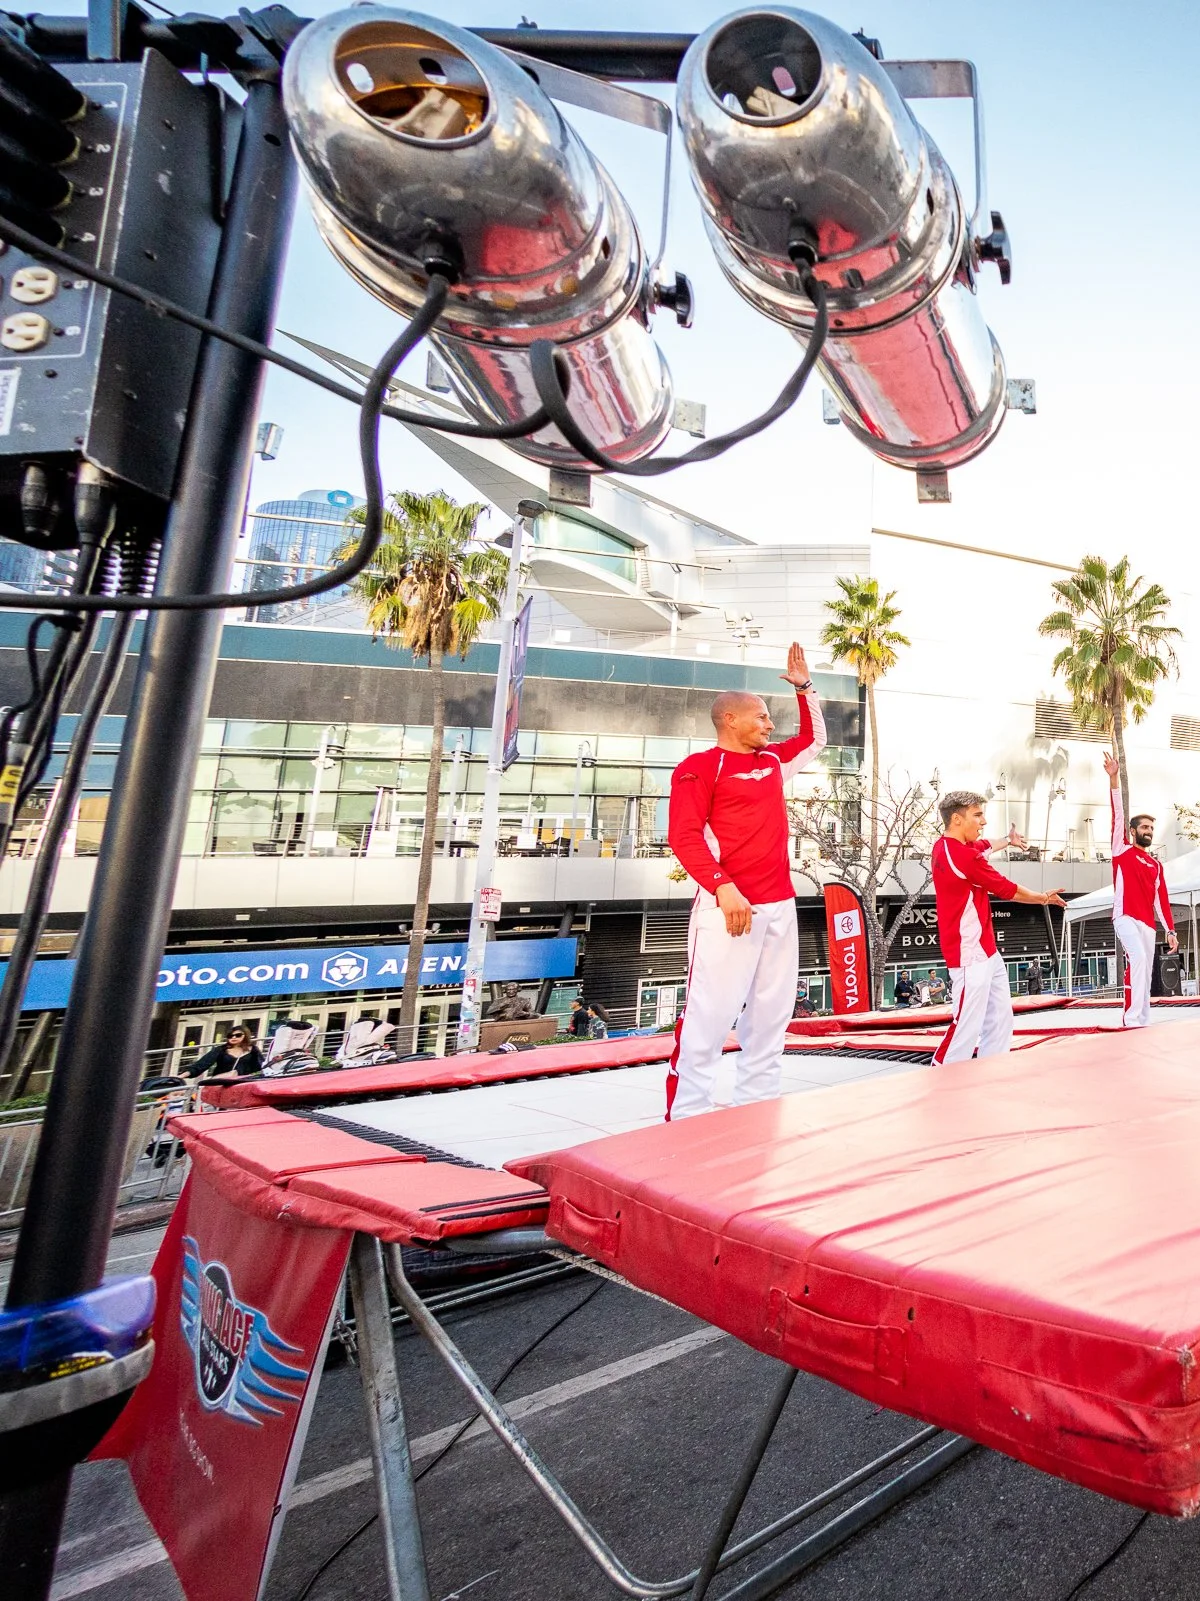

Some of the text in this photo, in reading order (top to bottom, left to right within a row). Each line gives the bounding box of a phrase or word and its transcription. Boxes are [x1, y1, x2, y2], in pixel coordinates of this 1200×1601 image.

[103, 100, 118, 110] 1
[96, 143, 112, 153] 2
[89, 186, 104, 197] 3
[80, 232, 96, 243] 4
[73, 279, 89, 290] 5
[902, 934, 937, 947] BOX
[156, 955, 467, 987] to.com AEN
[843, 942, 859, 1009] TOYOTA
